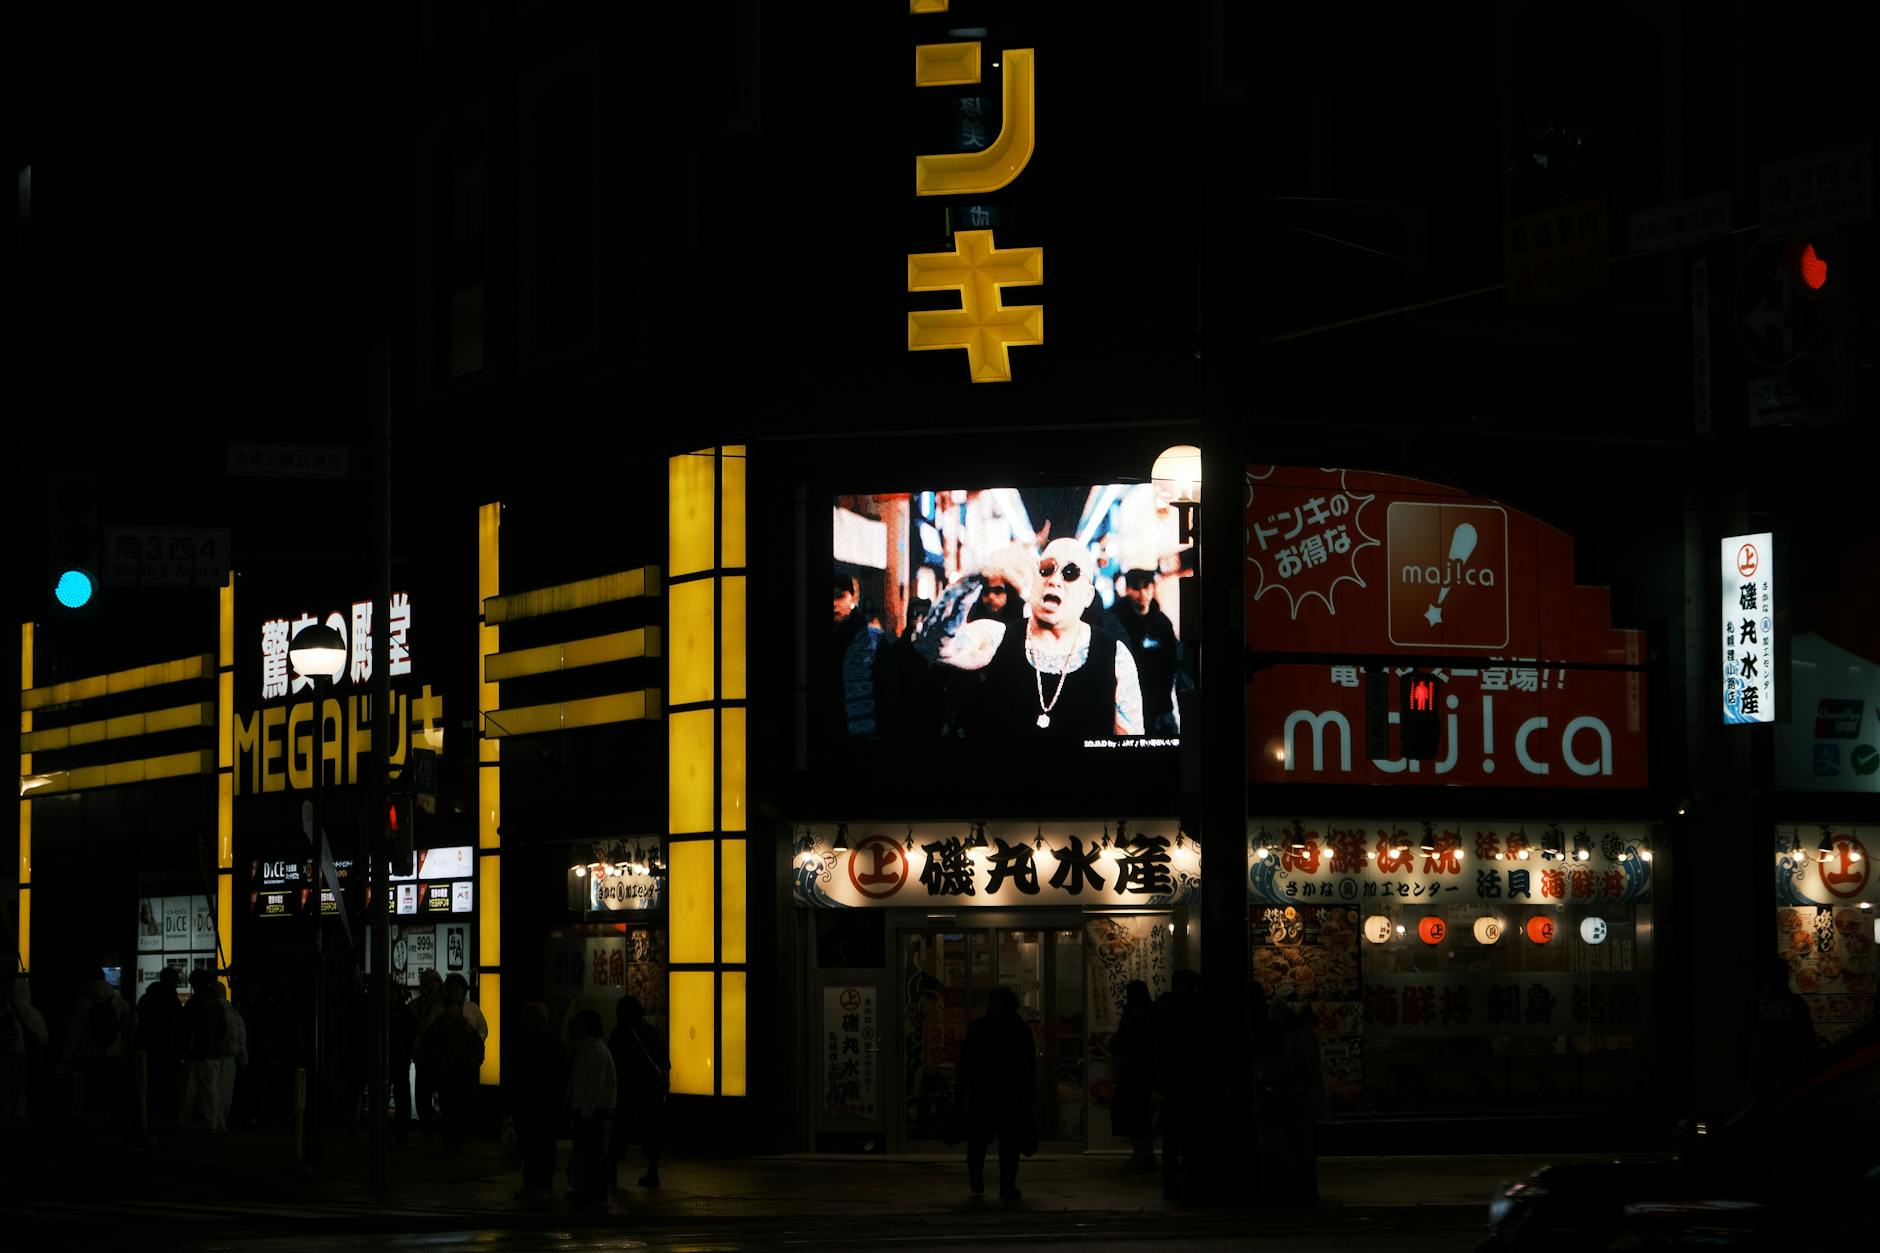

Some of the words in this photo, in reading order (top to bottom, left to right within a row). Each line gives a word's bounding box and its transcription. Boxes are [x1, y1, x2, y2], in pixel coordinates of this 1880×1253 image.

[115, 536, 218, 561] 南3西4
[1254, 493, 1351, 551] ドンキの
[1273, 524, 1352, 579] お得な
[1739, 582, 1760, 715] 磯丸水産
[852, 839, 904, 893] 上
[918, 833, 1178, 897] 磯丸水産
[1281, 828, 1462, 874] 海鮮浜焼
[1477, 869, 1531, 899] 活貝
[1540, 869, 1626, 899] 海鮮丼
